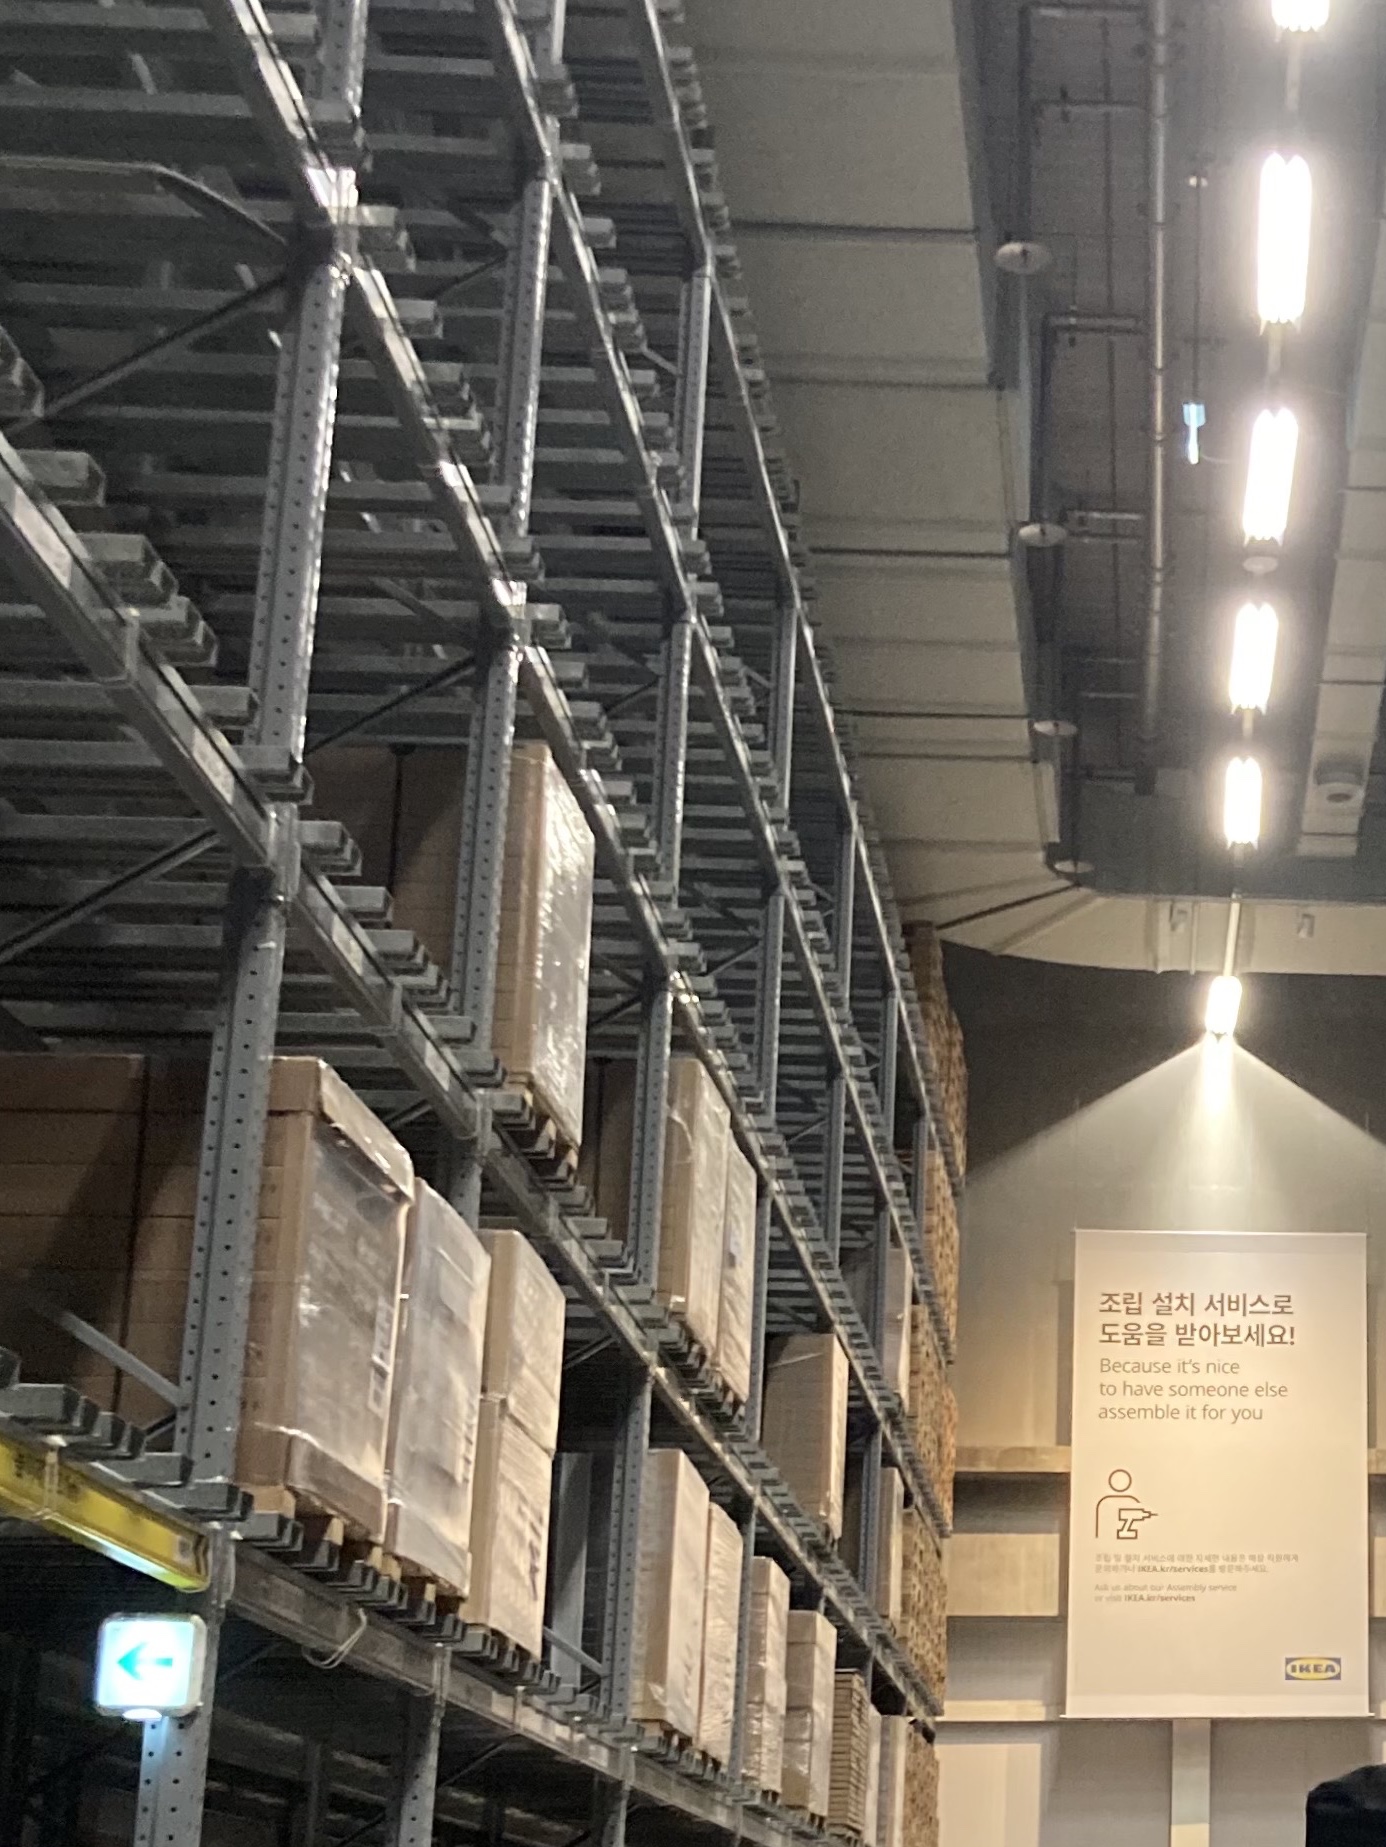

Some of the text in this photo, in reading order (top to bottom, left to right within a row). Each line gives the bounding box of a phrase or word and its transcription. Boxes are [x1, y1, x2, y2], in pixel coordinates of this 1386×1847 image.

[1098, 1291, 1295, 1317] 조립 설치 서비스로
[1098, 1322, 1296, 1348] 도움을 받아보세요!
[1099, 1357, 1241, 1375] Because it's nice
[1098, 1380, 1289, 1398] to have someone else
[1098, 1403, 1263, 1425] assemble it for you
